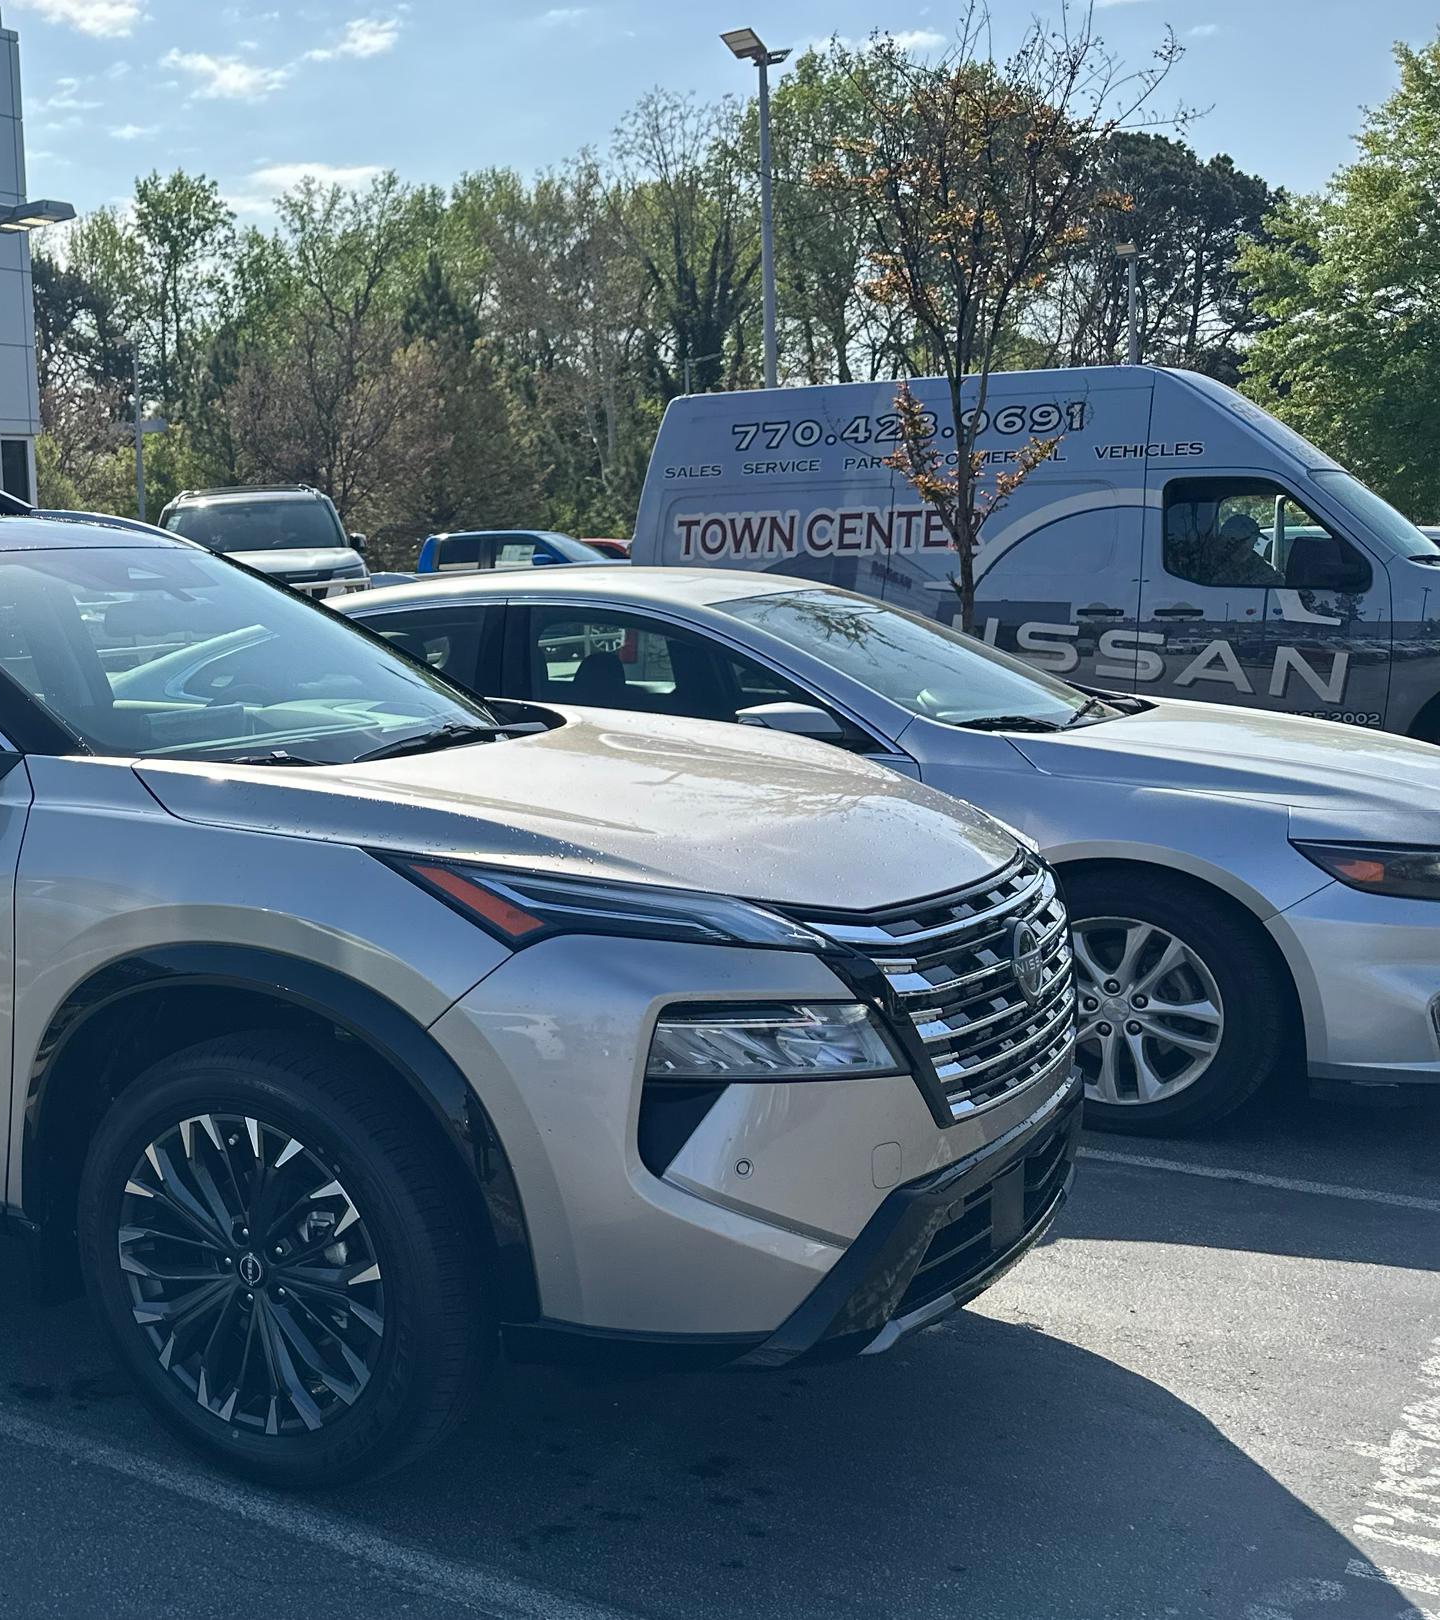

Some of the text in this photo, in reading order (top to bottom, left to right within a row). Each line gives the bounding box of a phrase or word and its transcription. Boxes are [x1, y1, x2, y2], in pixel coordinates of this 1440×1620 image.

[664, 464, 723, 479] SALES
[742, 459, 821, 475] SERVICE
[843, 455, 909, 470] PAR
[1093, 441, 1206, 461] VEHICLES
[676, 514, 797, 556] TOWN
[951, 614, 1351, 704] ISSAN
[1331, 711, 1382, 726] 2002
